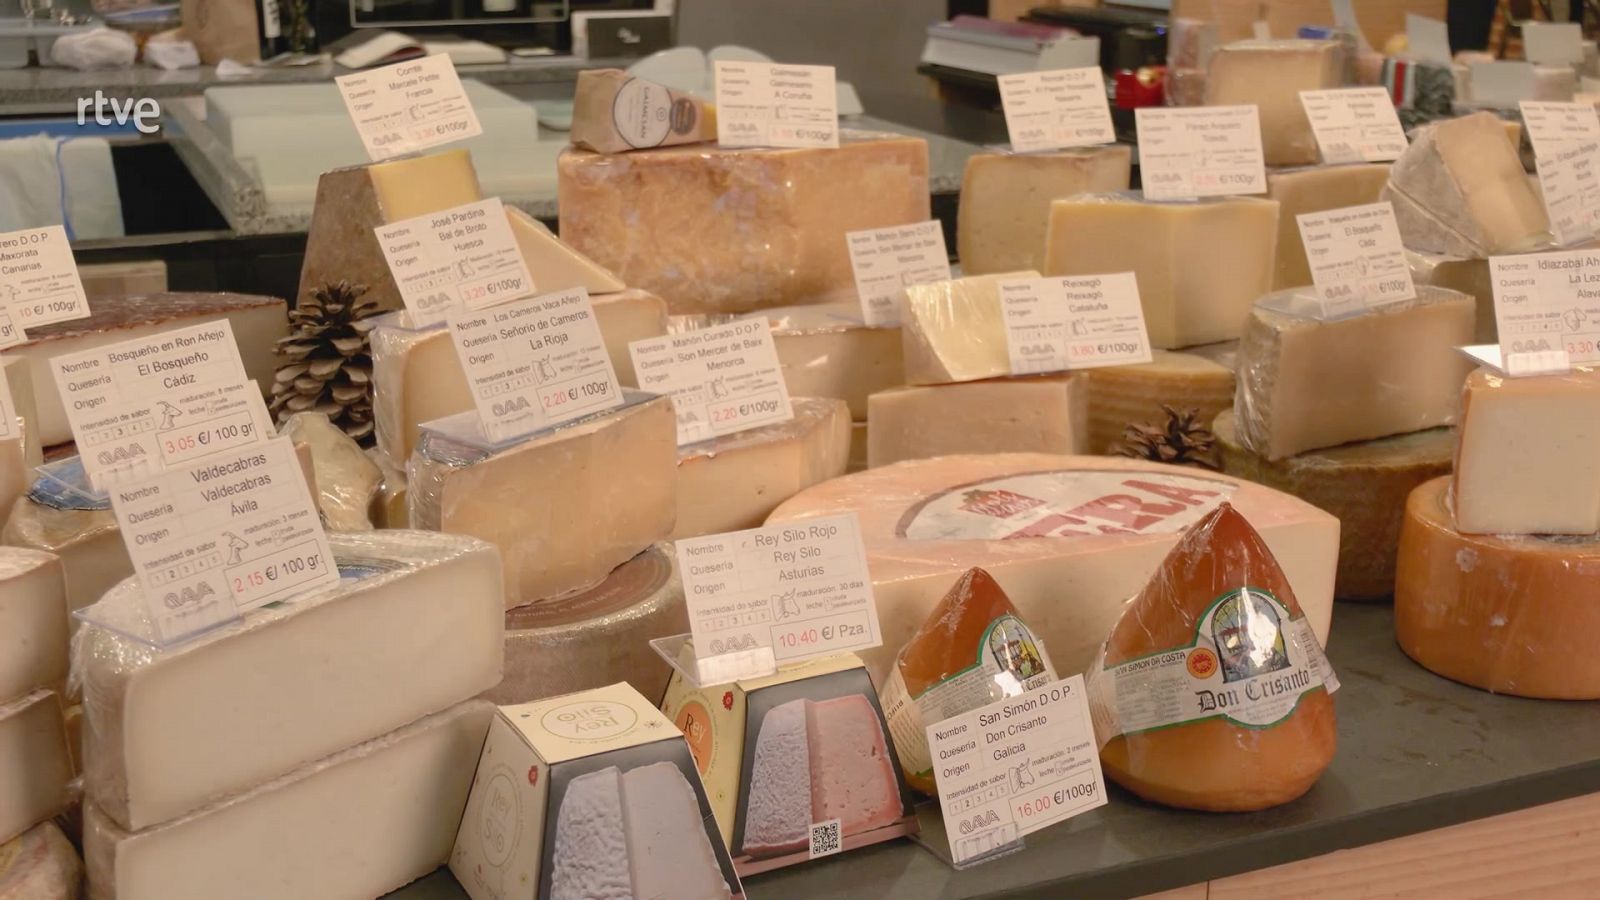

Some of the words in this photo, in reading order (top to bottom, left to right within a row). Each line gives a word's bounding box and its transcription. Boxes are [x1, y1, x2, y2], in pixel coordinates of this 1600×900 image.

[384, 227, 411, 240] Nombre
[431, 216, 452, 230] José
[453, 207, 486, 225] Pardina
[439, 230, 453, 242] Bal
[453, 228, 465, 239] de
[466, 222, 488, 237] Broto
[395, 256, 418, 268] Origen
[454, 238, 485, 252] Huesca
[1498, 262, 1529, 272] Nombre
[1, 262, 43, 276] Canarias
[1568, 273, 1582, 284] La
[487, 277, 524, 295] €/100gr
[1502, 293, 1529, 304] Origen
[456, 318, 488, 332] Nombre
[494, 312, 510, 324] Los
[510, 304, 543, 320] Cameros
[543, 300, 561, 312] Vaca
[561, 293, 582, 308] Añejo
[538, 318, 549, 331] de
[550, 310, 589, 328] Cameros
[61, 357, 100, 374] Nombre
[109, 343, 160, 364] Bosqueño
[161, 341, 175, 352] en
[175, 335, 197, 348] Ron
[198, 329, 226, 346] Añejo
[469, 353, 495, 366] Origen
[529, 338, 543, 351] La
[545, 332, 569, 350] Rioja
[673, 335, 703, 349] Mahón
[703, 329, 734, 343] Curado
[678, 352, 697, 363] Son
[697, 346, 729, 359] Mercer
[730, 342, 742, 352] de
[68, 375, 113, 393] Quesería
[137, 364, 151, 378] El
[153, 352, 210, 375] Bosqueño
[707, 357, 746, 372] Menorca
[74, 395, 107, 412] Origen
[163, 373, 197, 389] Cádiz
[80, 414, 119, 432] Intensidad
[119, 411, 131, 422] de
[131, 407, 151, 420] sabor
[713, 407, 738, 423] 2.20
[739, 399, 780, 417] €/100gr
[165, 435, 197, 455] 3.05
[198, 430, 212, 446] €/
[215, 425, 239, 441] 100
[240, 422, 254, 438] gr
[120, 484, 160, 505] Nombre
[191, 452, 267, 484] Valdecabras
[128, 504, 174, 526] Quesería
[201, 472, 273, 503] Valdecabras
[136, 527, 170, 546] Origen
[231, 499, 259, 518] Ávila
[144, 551, 185, 571] Intensidad
[185, 548, 196, 558] de
[197, 540, 217, 556] sabor
[686, 544, 725, 558] Nombre
[755, 533, 780, 549] Rey
[783, 529, 807, 544] Silo
[809, 524, 838, 540] Rojo
[234, 570, 265, 594] 2.15
[266, 566, 280, 582] €/
[282, 556, 306, 577] 100
[306, 553, 320, 571] gr
[690, 561, 734, 577] Quesería
[774, 550, 797, 565] Rey
[800, 546, 822, 559] Silo
[694, 582, 726, 597] Origen
[778, 564, 825, 582] Asturias
[838, 581, 849, 592] 30
[697, 604, 736, 618] Intensidad
[736, 602, 747, 611] de
[748, 599, 768, 610] sabor
[806, 600, 823, 610] leche
[779, 629, 818, 649] 10.40
[822, 625, 836, 642] €/
[839, 622, 868, 638] Pza.
[1161, 652, 1187, 665] COSTA
[1195, 689, 1241, 713] Don
[1245, 668, 1311, 702] Crisanto
[936, 723, 969, 742] Nombre
[979, 711, 1001, 728] San
[1003, 698, 1038, 720] Simón
[939, 740, 977, 761] Quesería
[986, 729, 1007, 745] Don
[1008, 714, 1048, 737] Crisanto
[1071, 741, 1091, 753] meses
[943, 762, 971, 780] Origen
[994, 742, 1027, 762] Galicia
[1039, 767, 1055, 778] leche
[947, 781, 980, 801] Intensidad
[979, 778, 989, 788] de
[989, 771, 1007, 785] sabor
[1054, 780, 1099, 806] €/100gr
